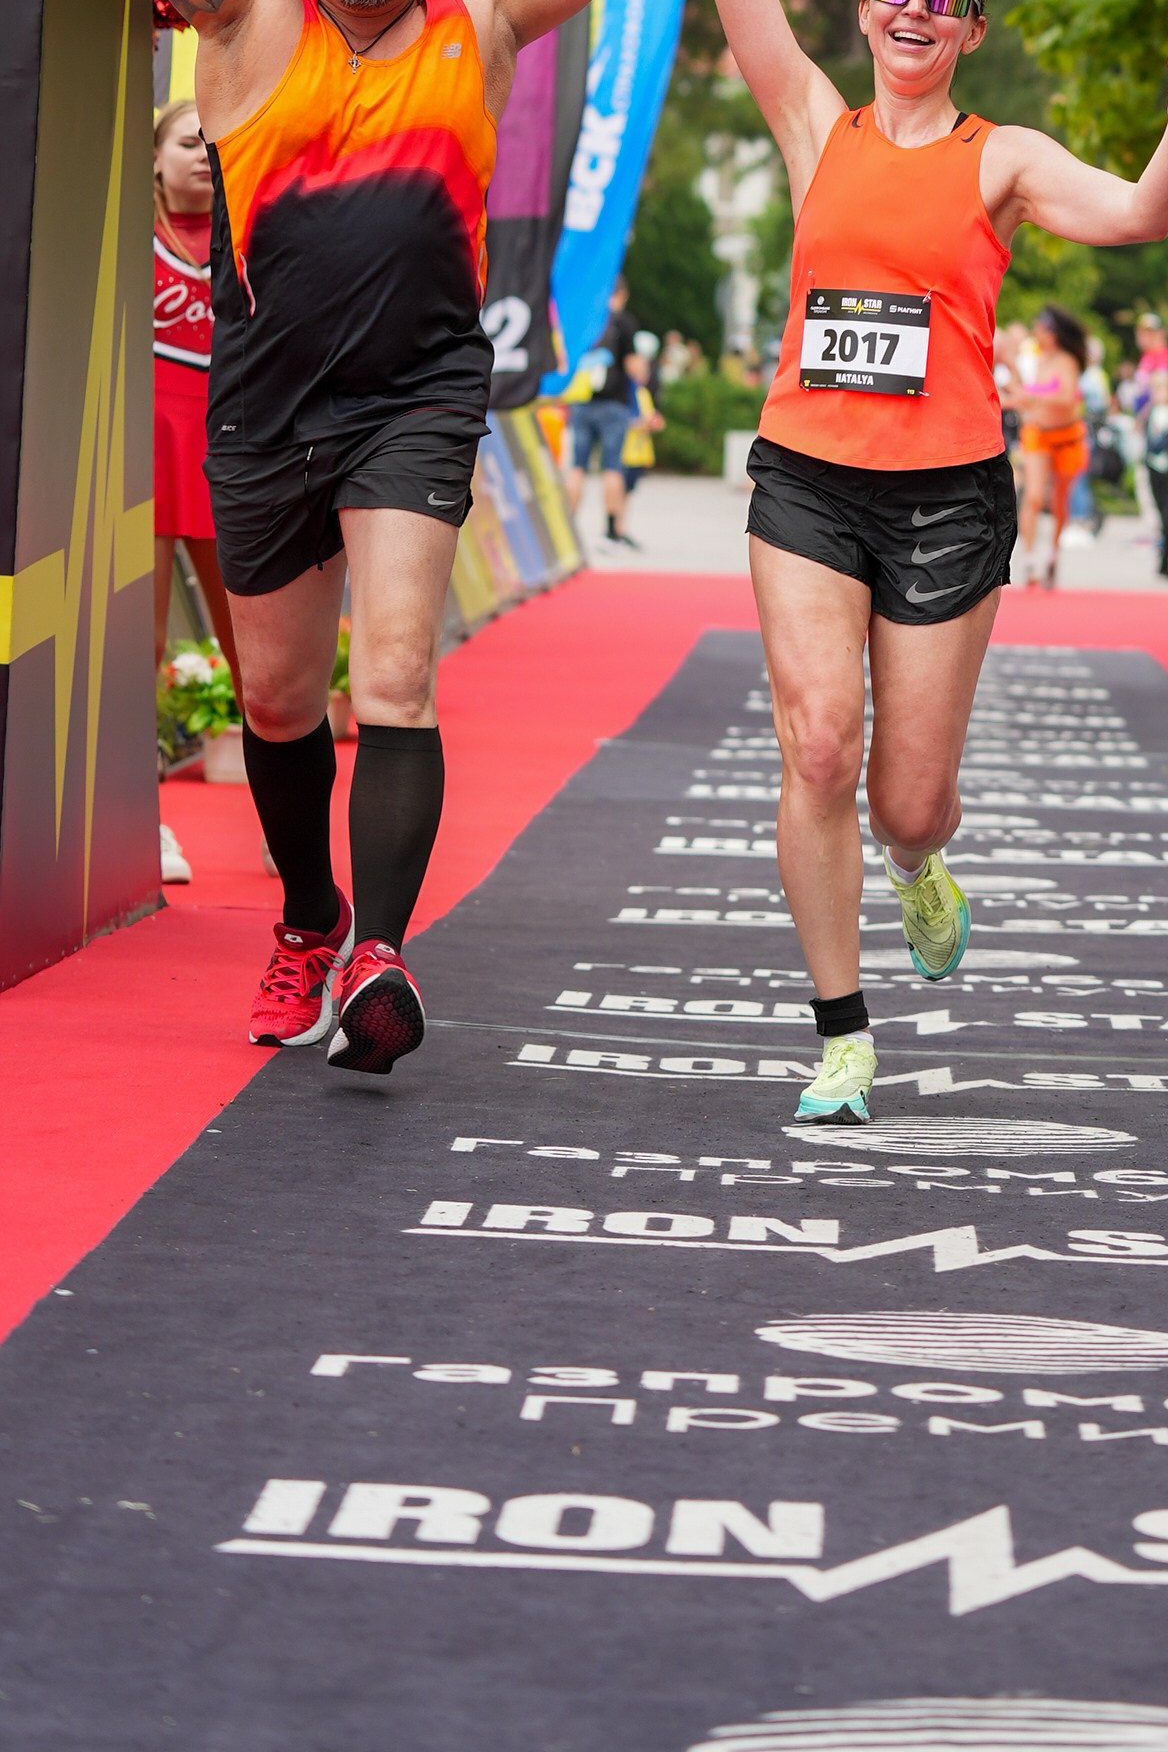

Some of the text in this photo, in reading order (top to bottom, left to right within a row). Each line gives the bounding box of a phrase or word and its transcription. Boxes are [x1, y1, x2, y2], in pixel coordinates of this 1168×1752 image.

[821, 328, 900, 366] 2017
[835, 372, 874, 386] NATALYA
[420, 1200, 840, 1245] IRON
[243, 1478, 825, 1559] IRON
